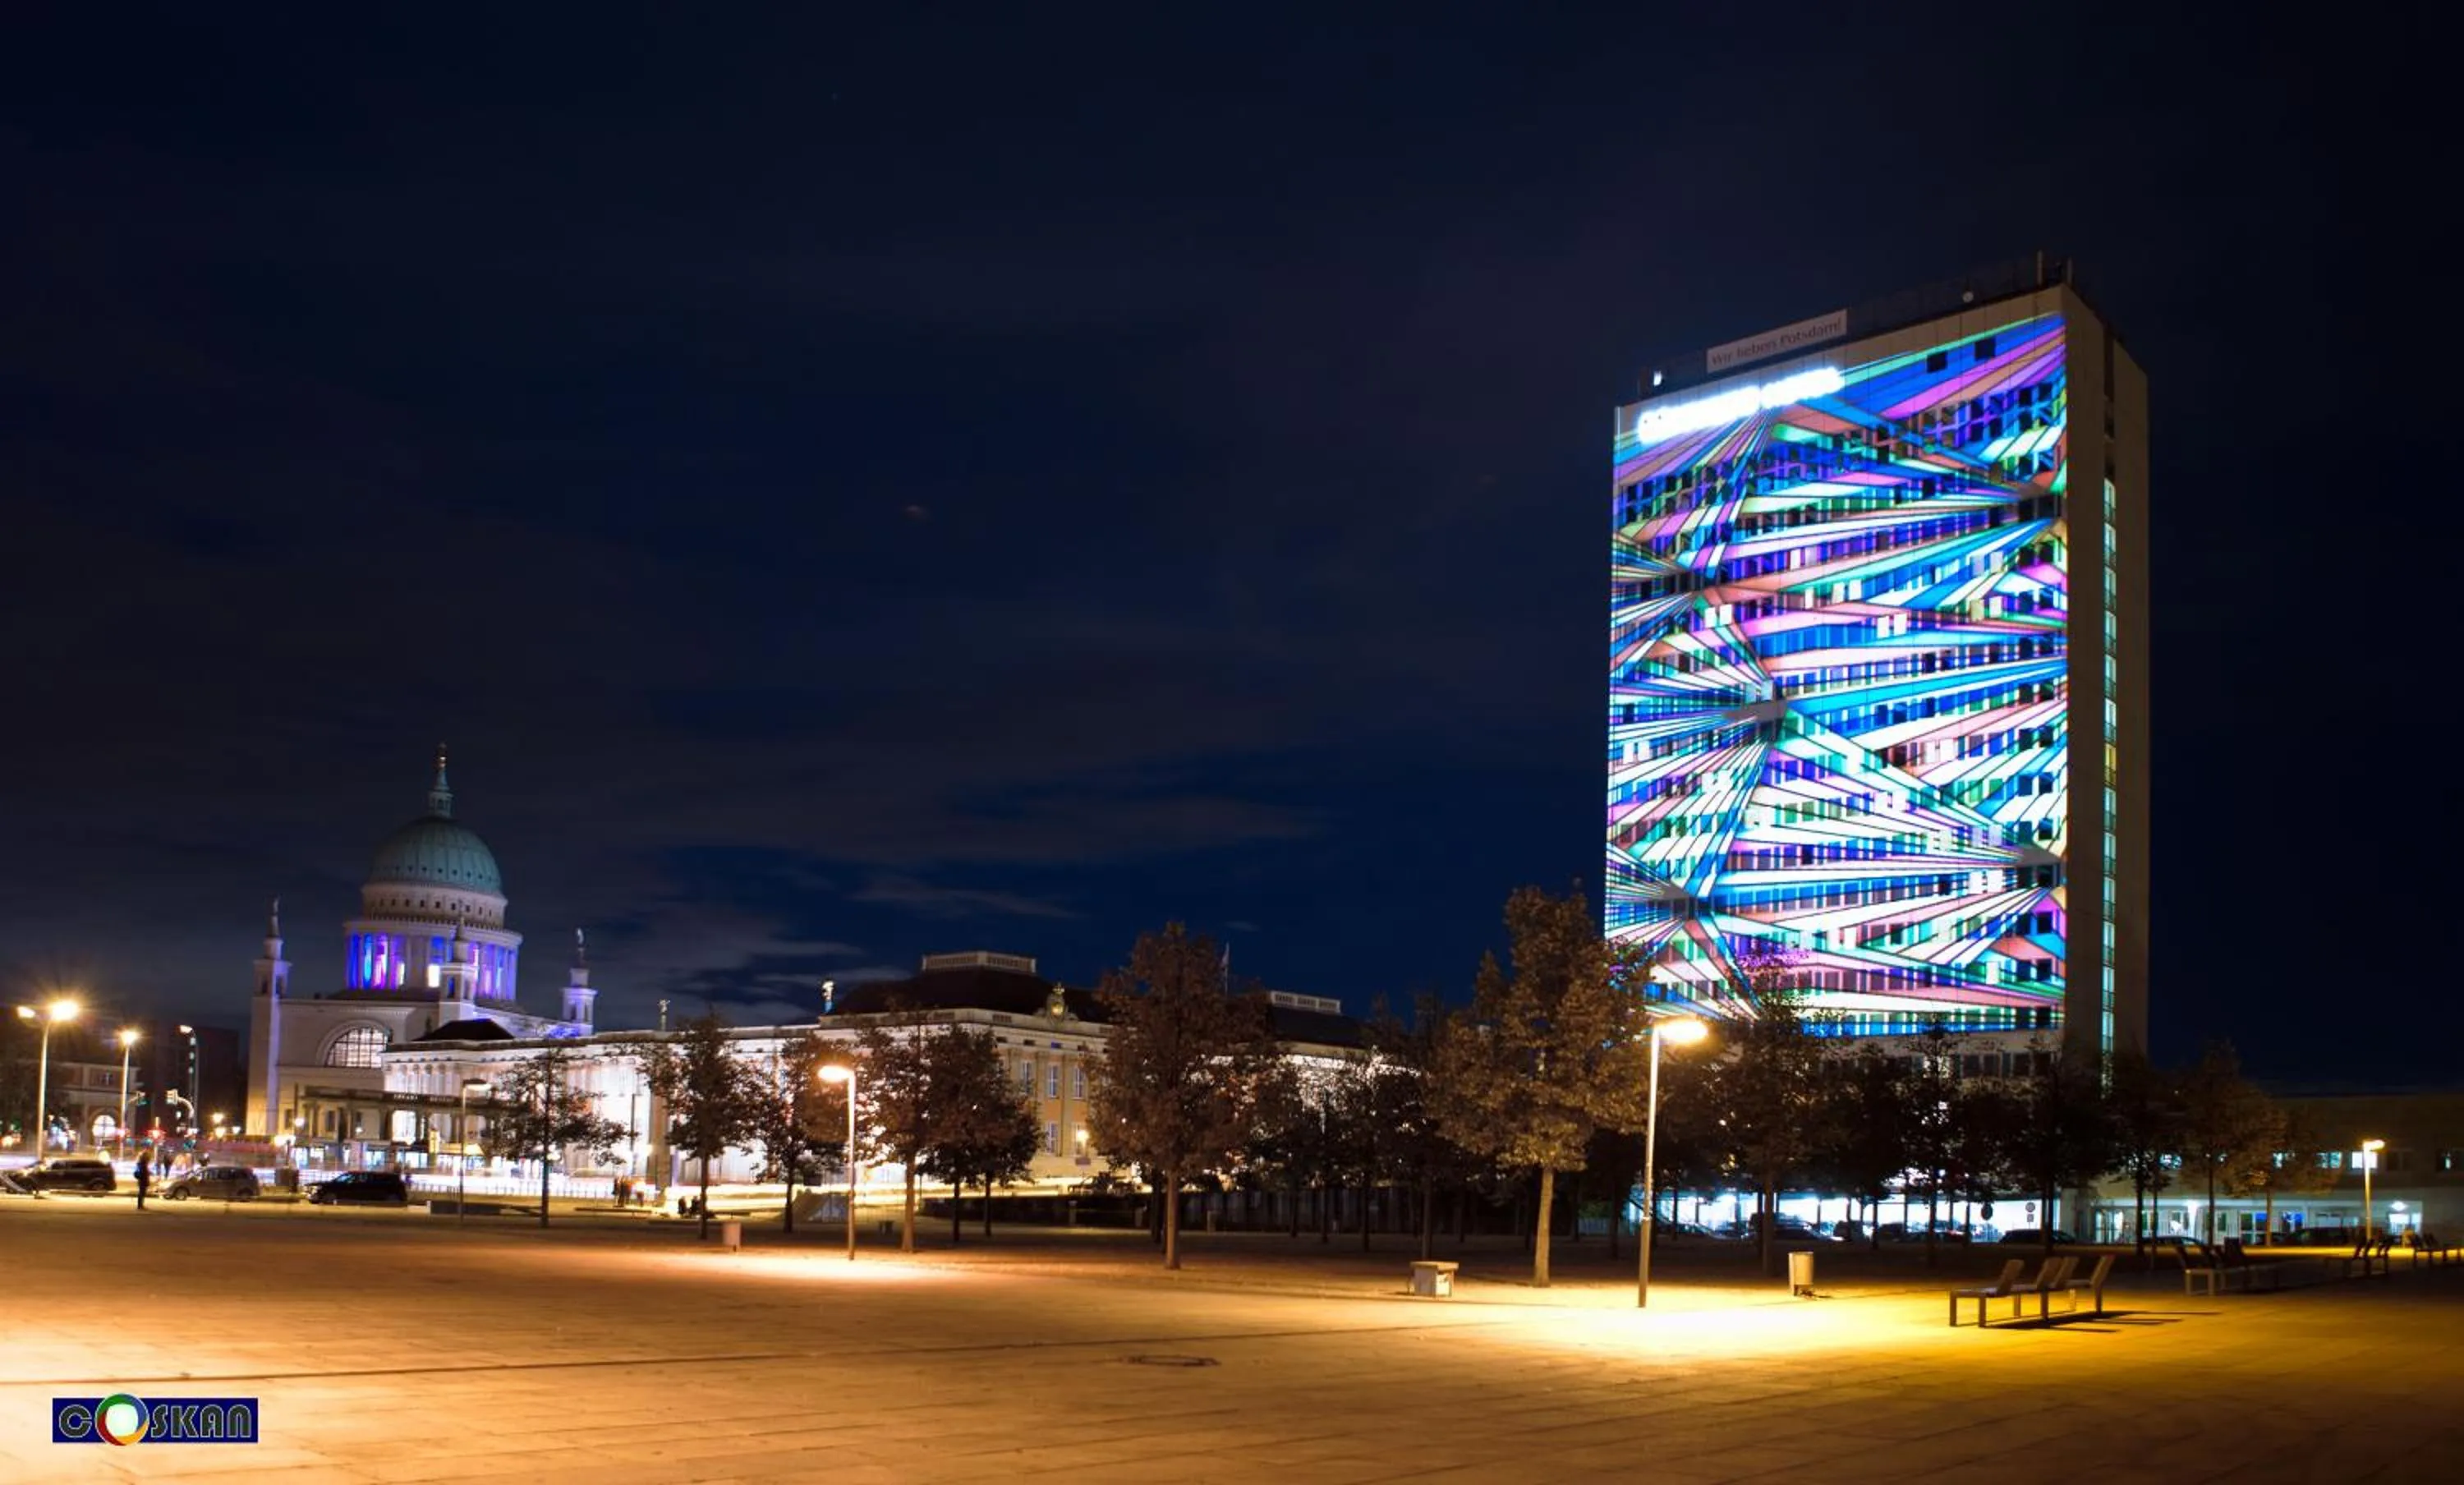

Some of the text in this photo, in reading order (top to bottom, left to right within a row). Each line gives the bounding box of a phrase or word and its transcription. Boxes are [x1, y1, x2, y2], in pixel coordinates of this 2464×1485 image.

[1711, 316, 1841, 366] Wir lieben Potsdam!
